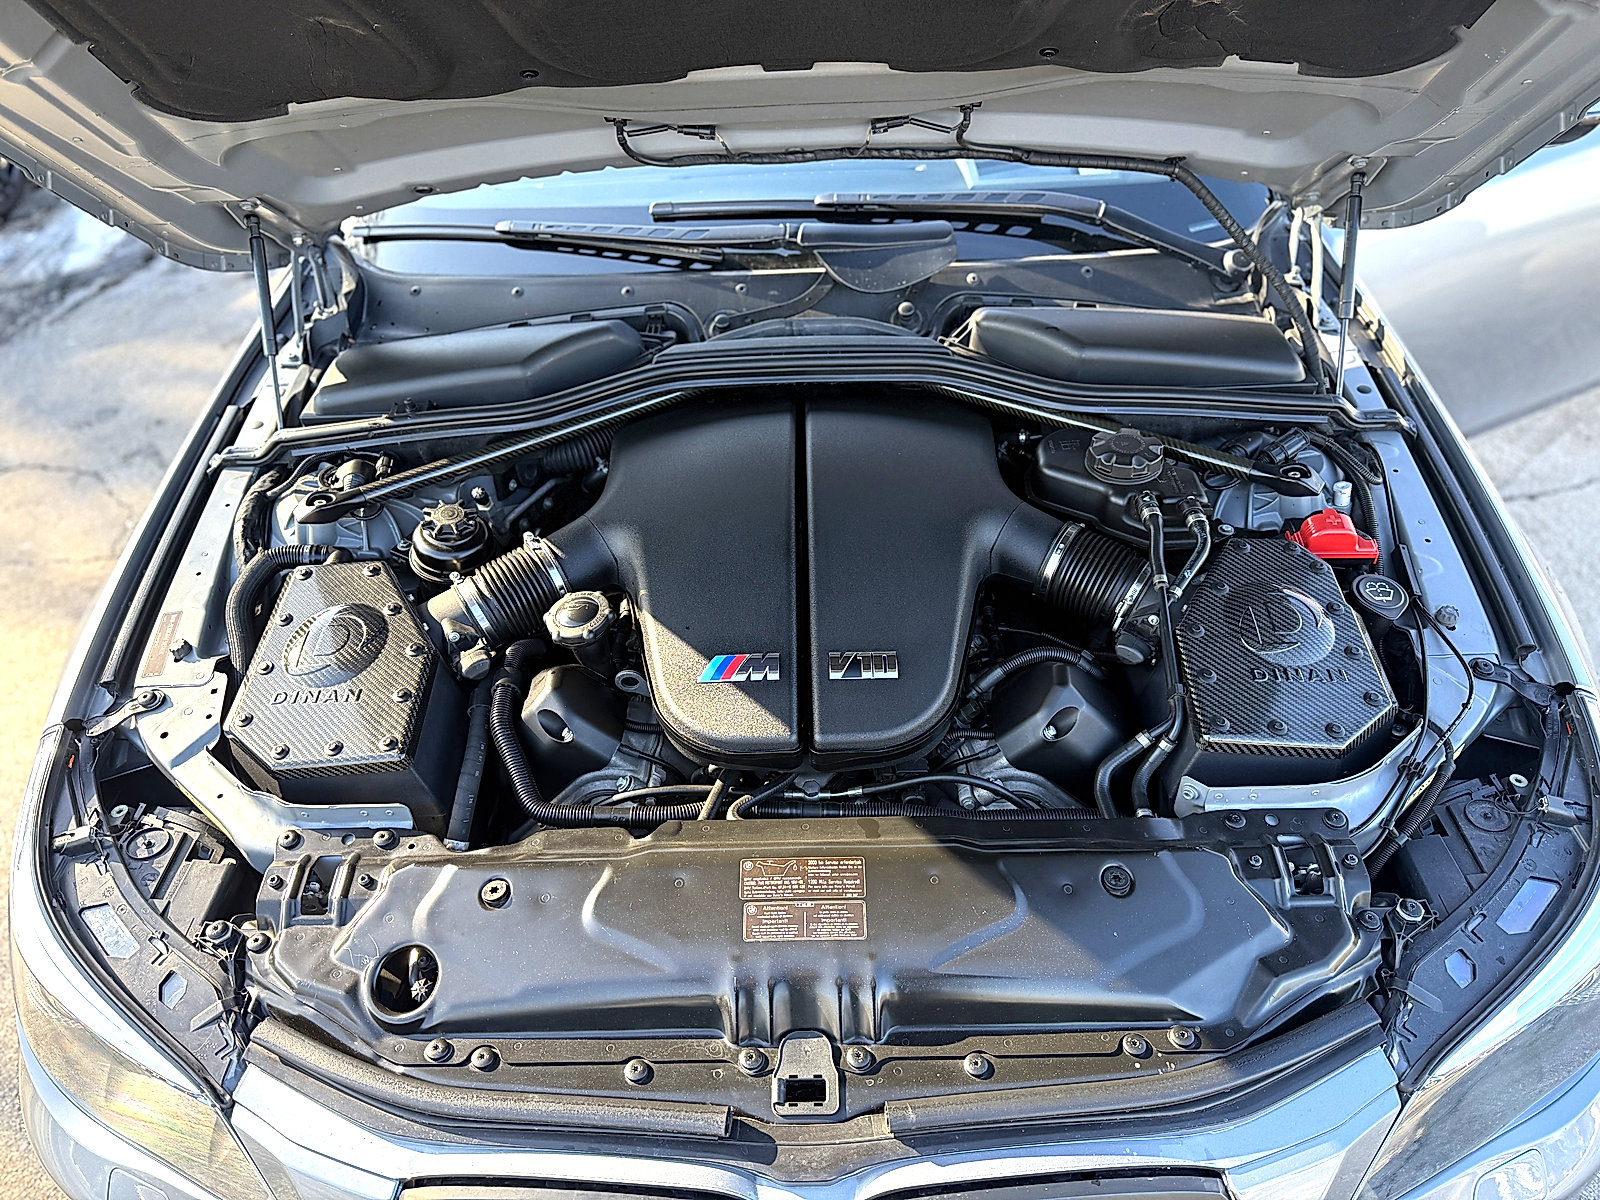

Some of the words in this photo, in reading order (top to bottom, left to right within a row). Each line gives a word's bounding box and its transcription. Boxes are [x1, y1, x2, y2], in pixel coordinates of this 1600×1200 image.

[828, 651, 899, 680] V10
[1252, 668, 1350, 683] DINAN
[270, 688, 364, 706] DINAN
